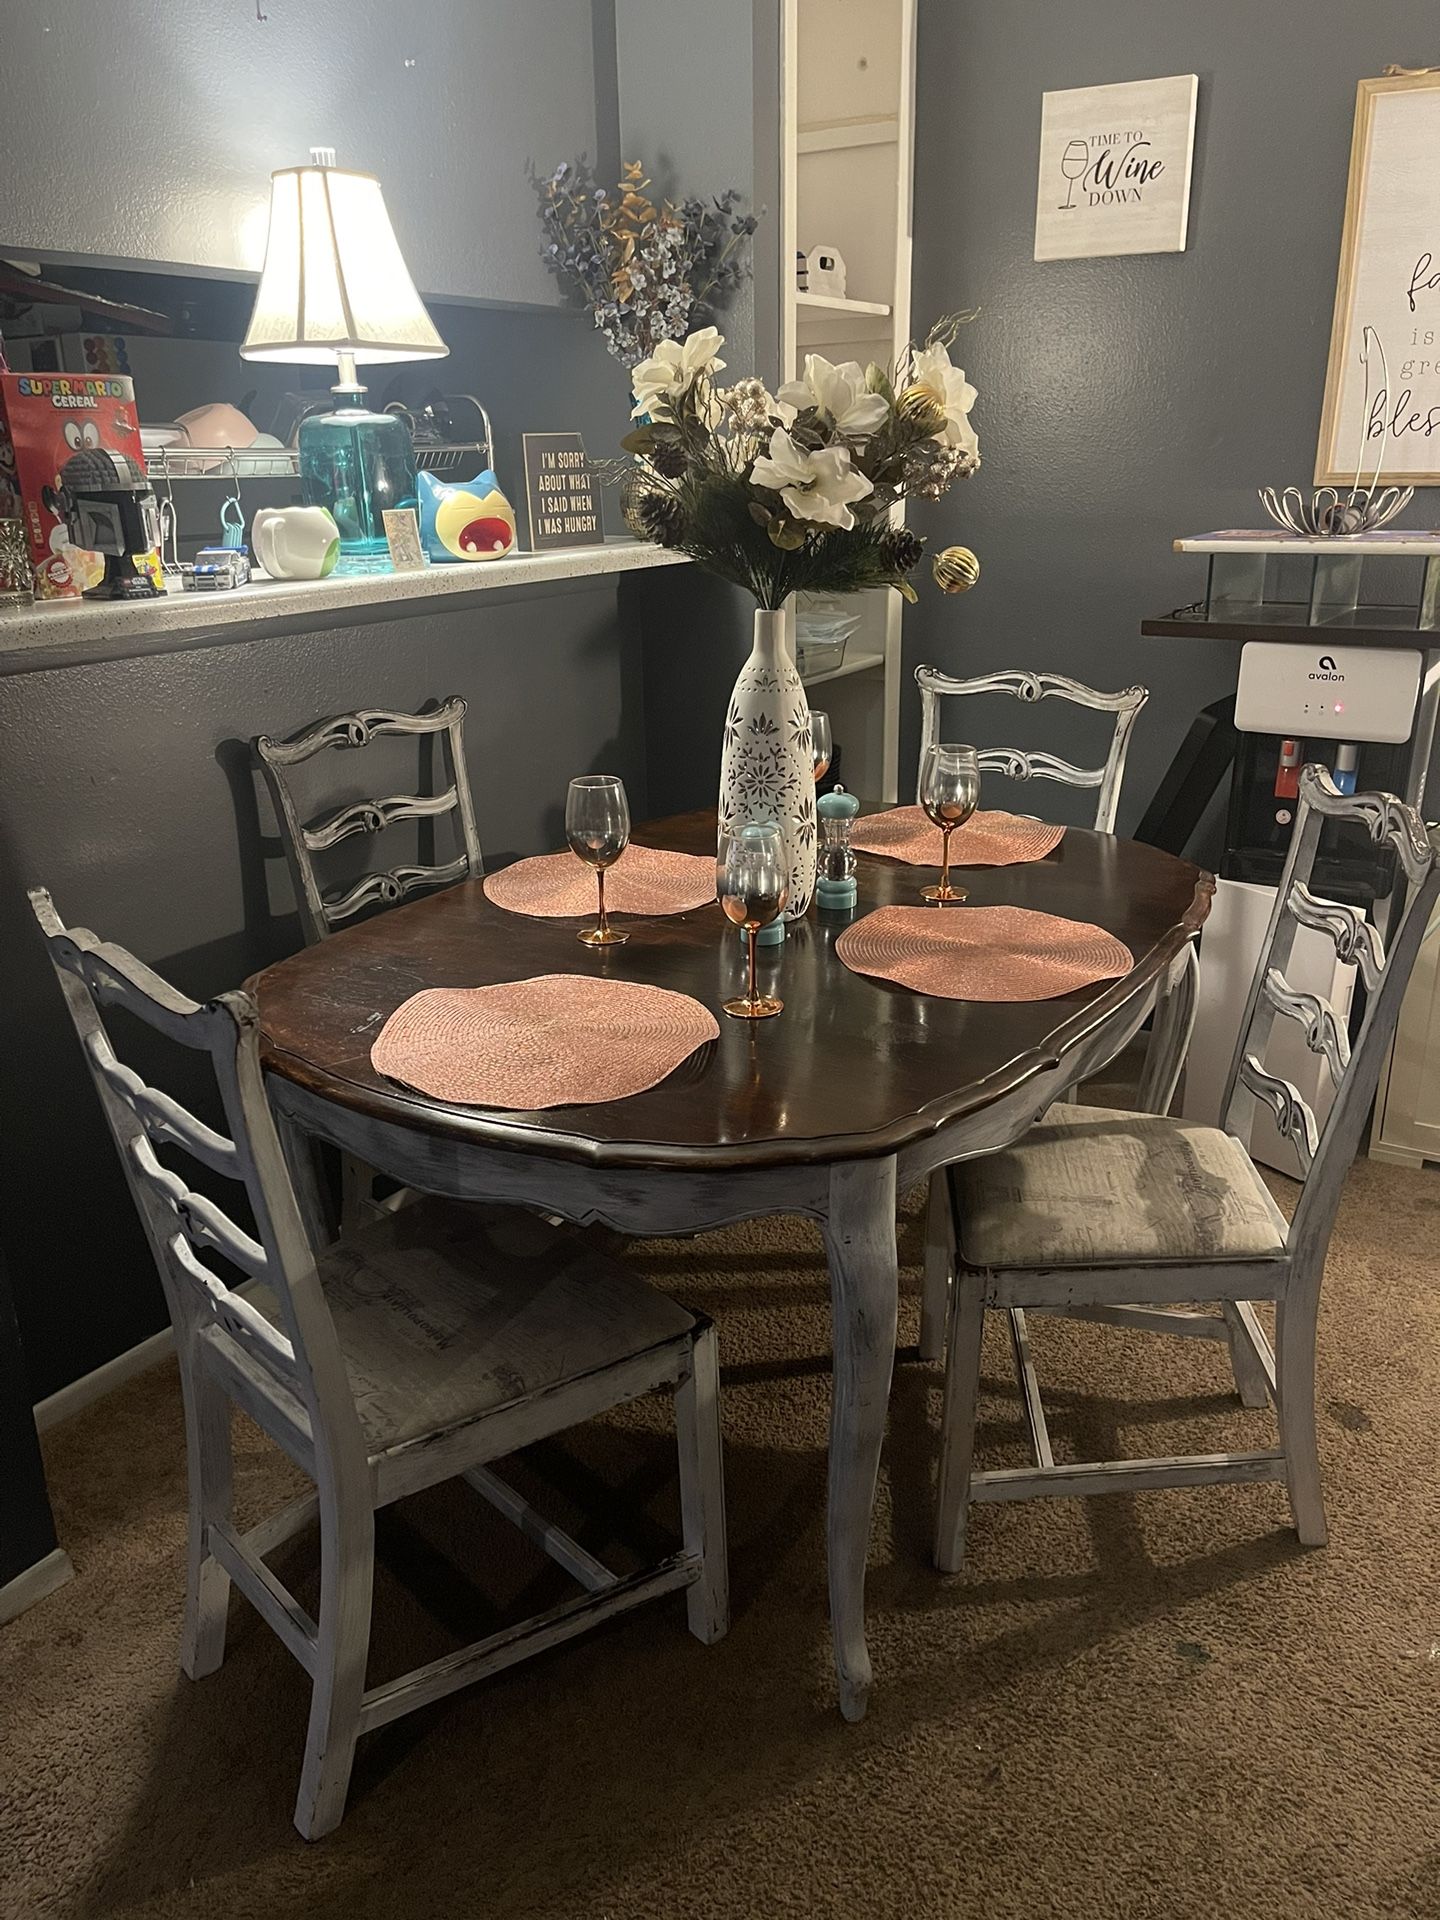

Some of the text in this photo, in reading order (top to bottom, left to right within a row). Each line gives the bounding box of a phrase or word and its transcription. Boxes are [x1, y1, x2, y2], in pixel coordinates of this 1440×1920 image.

[1089, 130, 1143, 147] TIME TO
[1082, 141, 1165, 192] Wine
[1089, 187, 1143, 207] DOWN
[1410, 327, 1434, 345] is
[18, 377, 123, 397] SUPER MARIO
[52, 395, 98, 408] CEREAL
[542, 452, 585, 469] I'M SORRY
[539, 474, 591, 492] ABOUT WHAT
[541, 495, 593, 514] I SAID WHEN
[538, 515, 597, 535] I WAS HUNGRY
[1308, 671, 1345, 682] avalon
